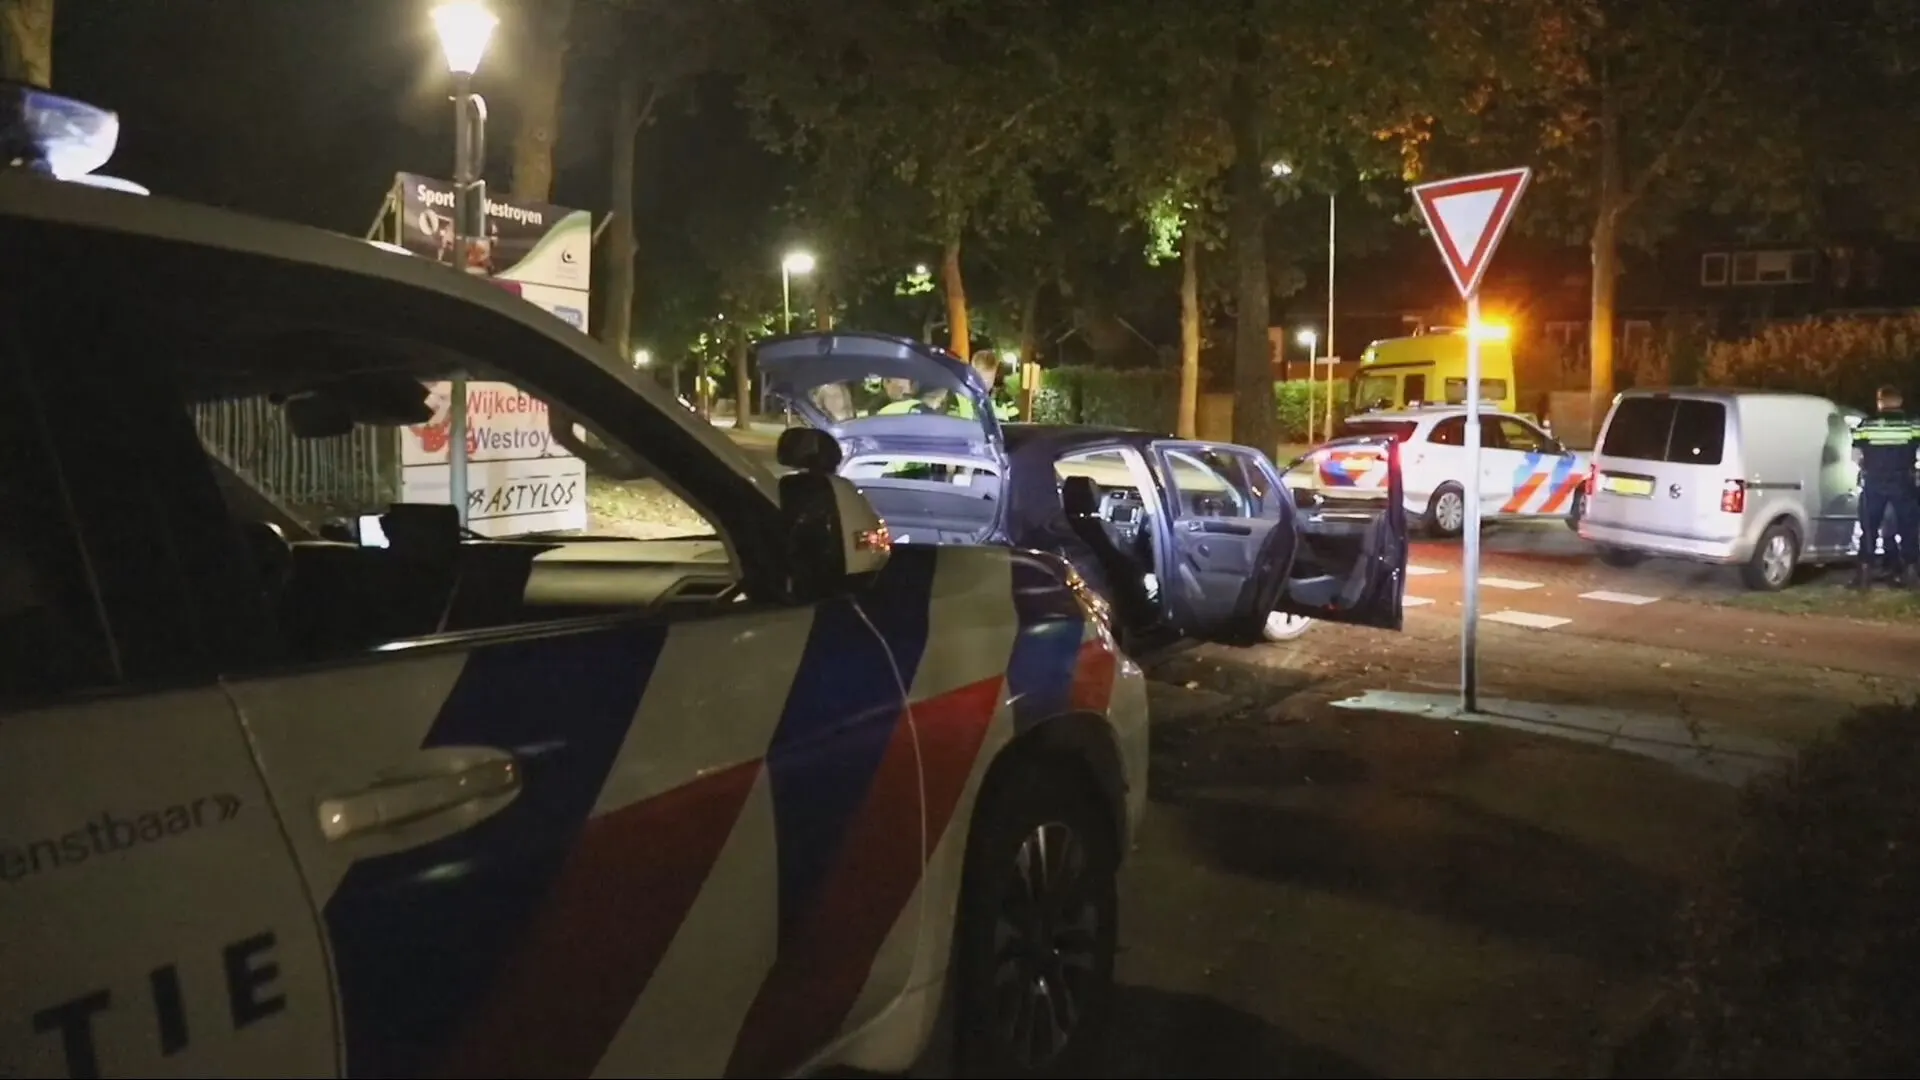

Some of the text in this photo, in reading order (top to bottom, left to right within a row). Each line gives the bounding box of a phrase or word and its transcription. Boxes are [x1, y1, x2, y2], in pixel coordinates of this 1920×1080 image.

[416, 184, 456, 208] Sport
[484, 480, 577, 513] ASTYLOS
[32, 930, 287, 1078] TIE
